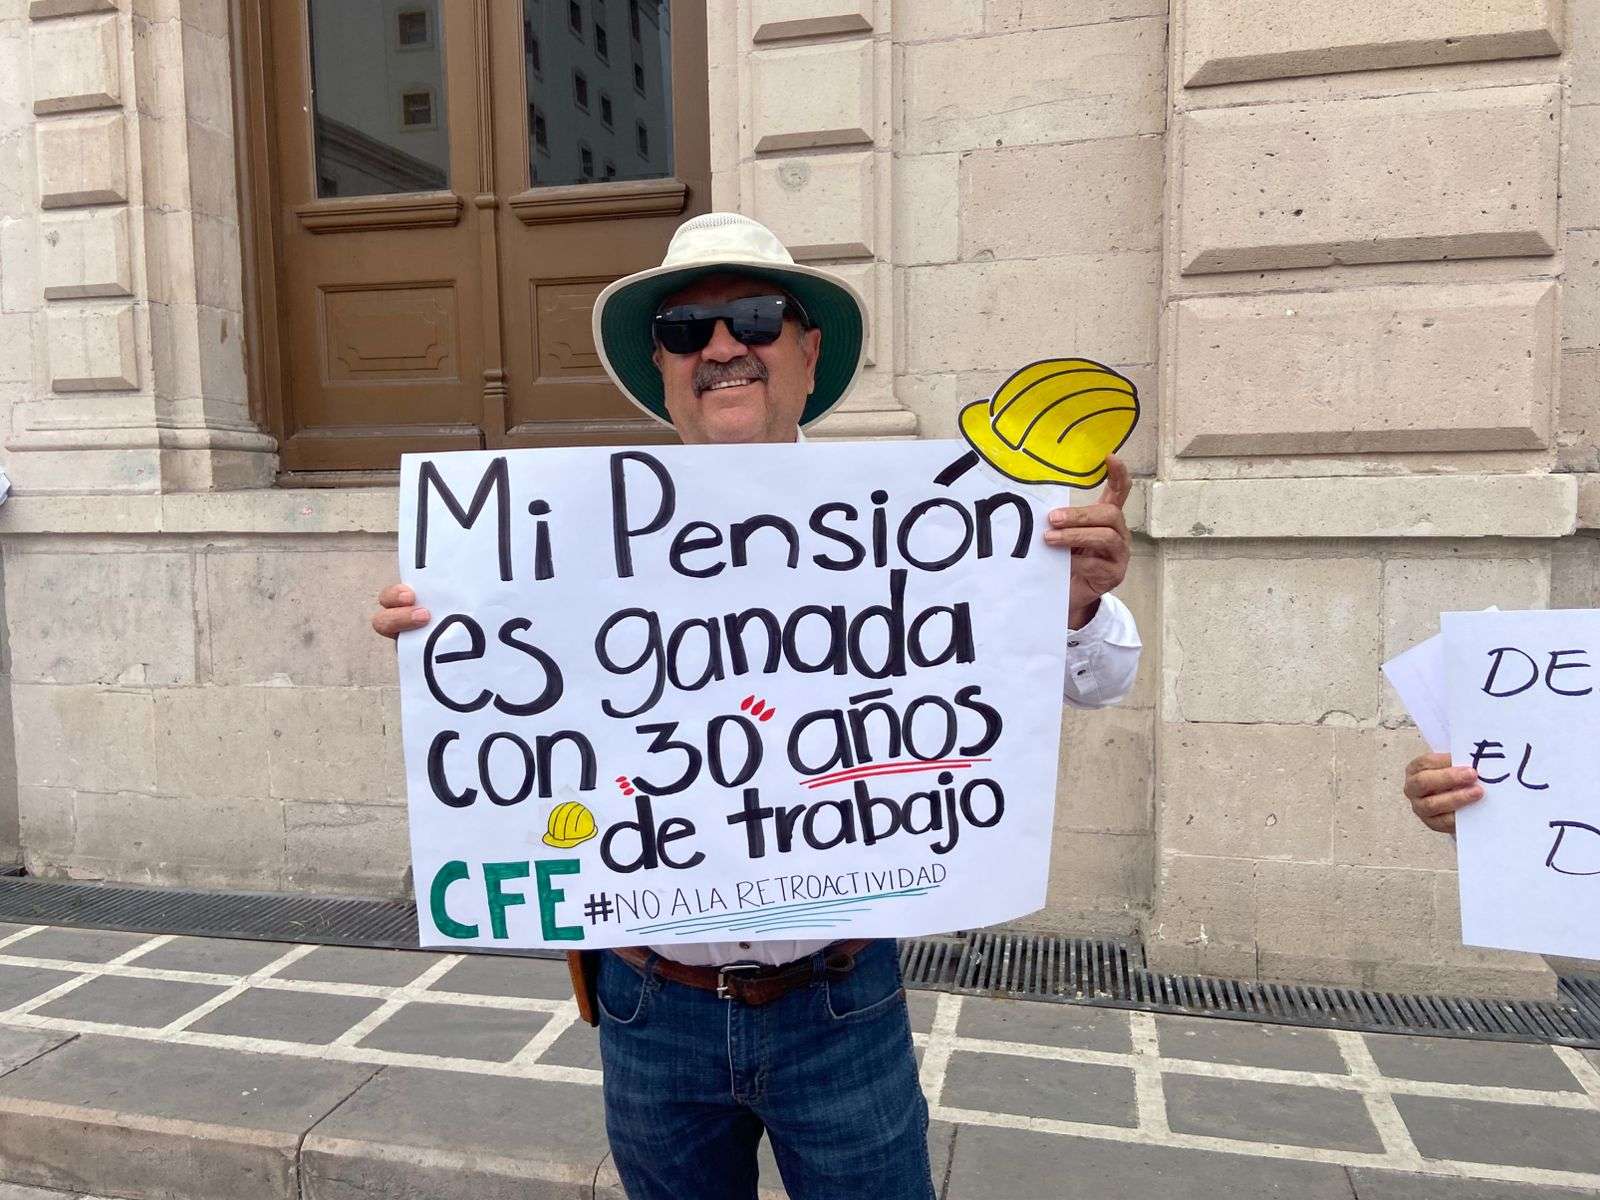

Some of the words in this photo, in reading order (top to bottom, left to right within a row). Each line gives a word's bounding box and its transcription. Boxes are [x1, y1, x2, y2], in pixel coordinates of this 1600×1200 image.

[415, 456, 554, 581] Mi
[610, 450, 1034, 578] Pensión
[424, 613, 564, 716] es
[595, 568, 975, 718] ganada
[428, 730, 597, 808] con
[632, 714, 763, 796] 30
[787, 685, 1003, 776] años
[1470, 739, 1550, 790] EL
[600, 795, 706, 873] de
[727, 771, 1005, 859] trabajo
[430, 859, 585, 941] CFE
[584, 889, 661, 925] #NO
[736, 863, 947, 909] RETROACTIVIDAD
